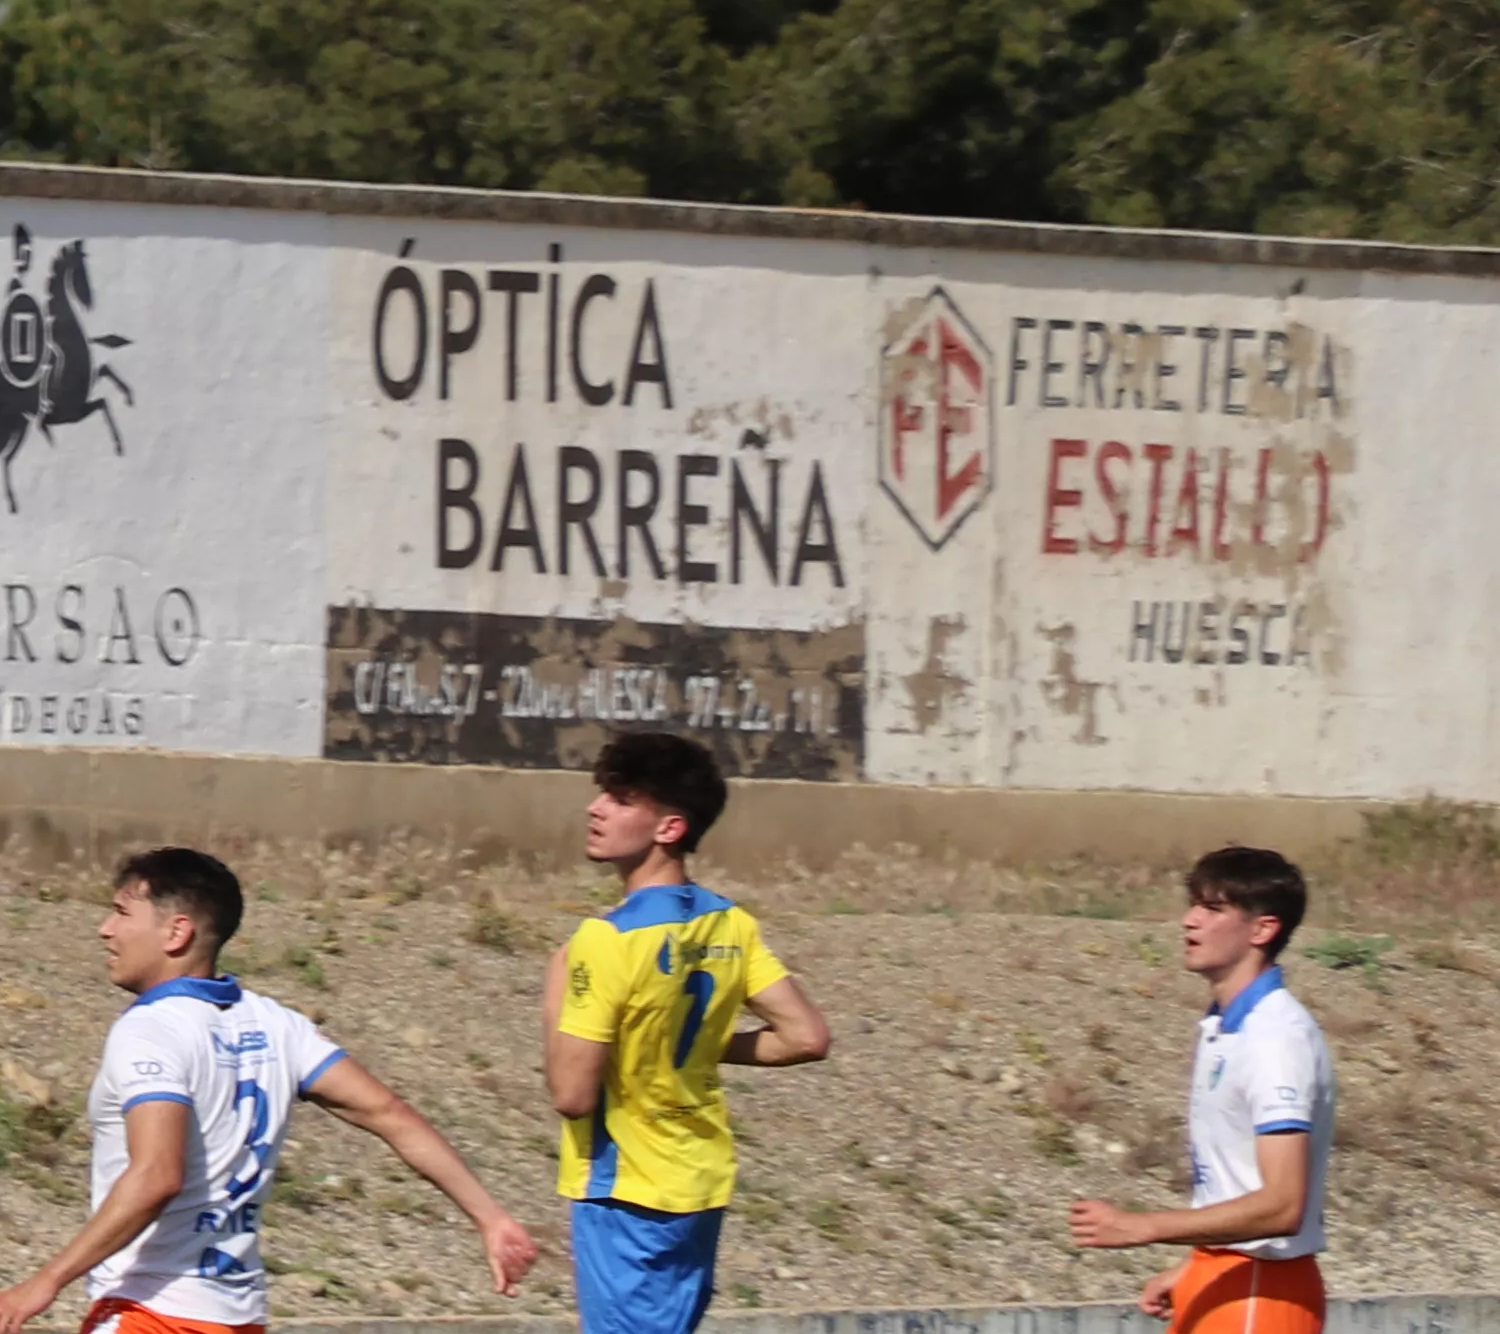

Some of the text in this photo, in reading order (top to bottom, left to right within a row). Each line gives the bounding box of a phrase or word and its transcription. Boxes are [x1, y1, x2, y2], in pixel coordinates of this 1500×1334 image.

[1006, 316, 1340, 417] FERRETERA
[436, 427, 846, 588] BARREÑA
[1127, 599, 1314, 668] HUESCA
